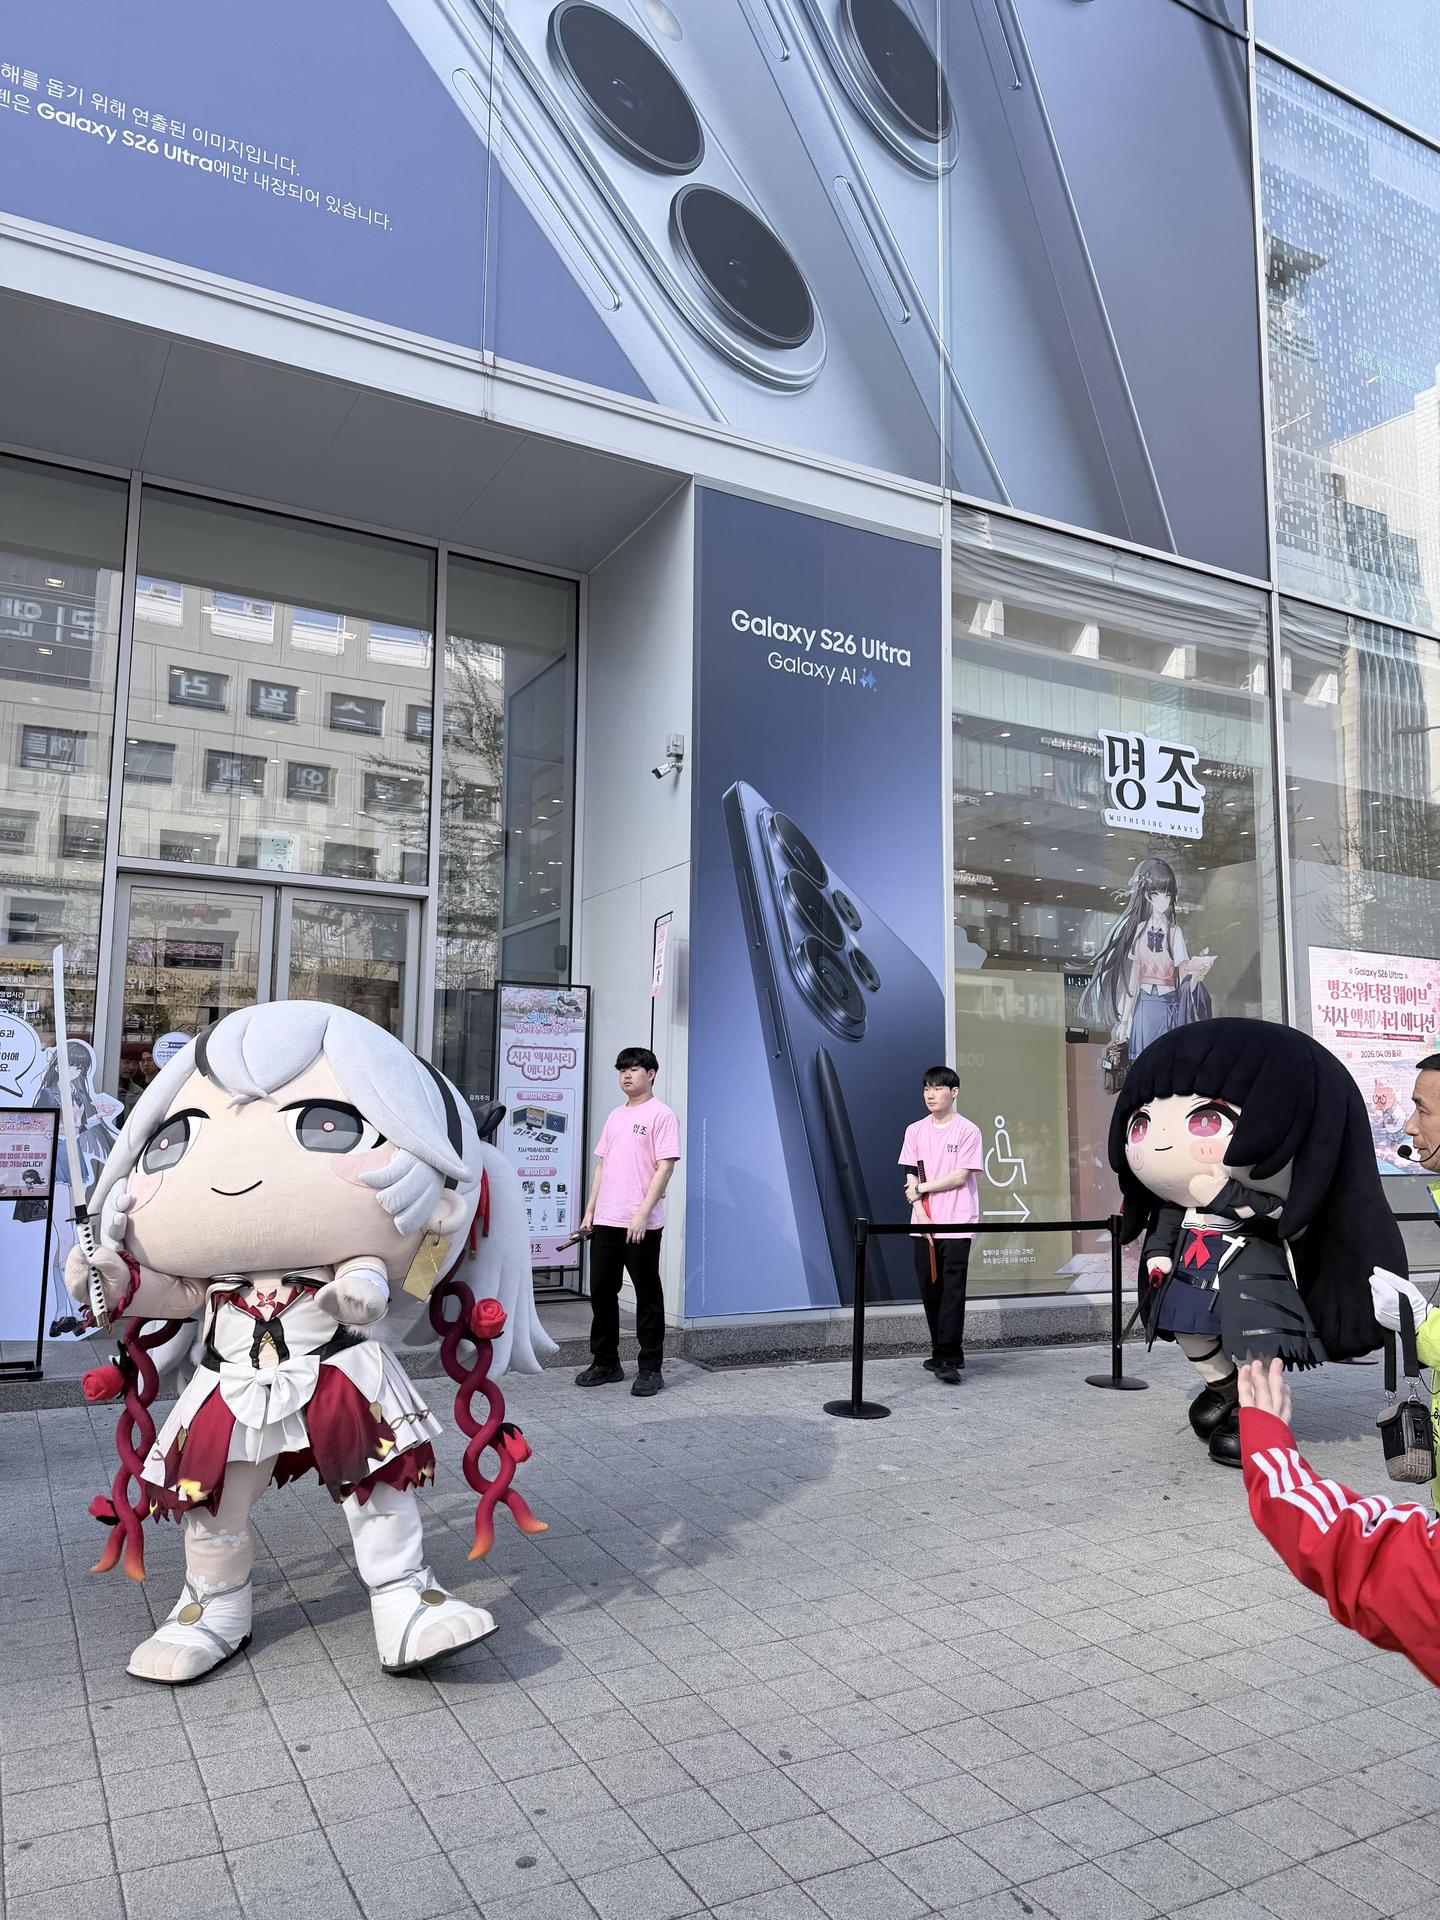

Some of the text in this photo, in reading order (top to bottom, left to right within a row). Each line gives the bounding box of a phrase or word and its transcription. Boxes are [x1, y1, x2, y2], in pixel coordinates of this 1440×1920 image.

[1, 62, 301, 177] 해를 돕기 위해 연출된 이미지입니다.
[37, 102, 118, 144] Galaxy
[122, 129, 160, 155] S26
[163, 143, 249, 185] Ultra에만
[254, 173, 320, 208] 내장되어
[325, 194, 394, 231] 있습니다.
[731, 609, 911, 667] Galaxy S26 Ultra
[768, 651, 856, 686] Galaxy AI
[1105, 735, 1201, 814] 명조
[1109, 814, 1200, 835] WUTHERING WAVES
[1354, 967, 1404, 979] Galaxy S26 Ultra
[1327, 979, 1430, 1006] 명조:워더링 웨이브
[1322, 1005, 1436, 1033] 치사 액세서리 에디션
